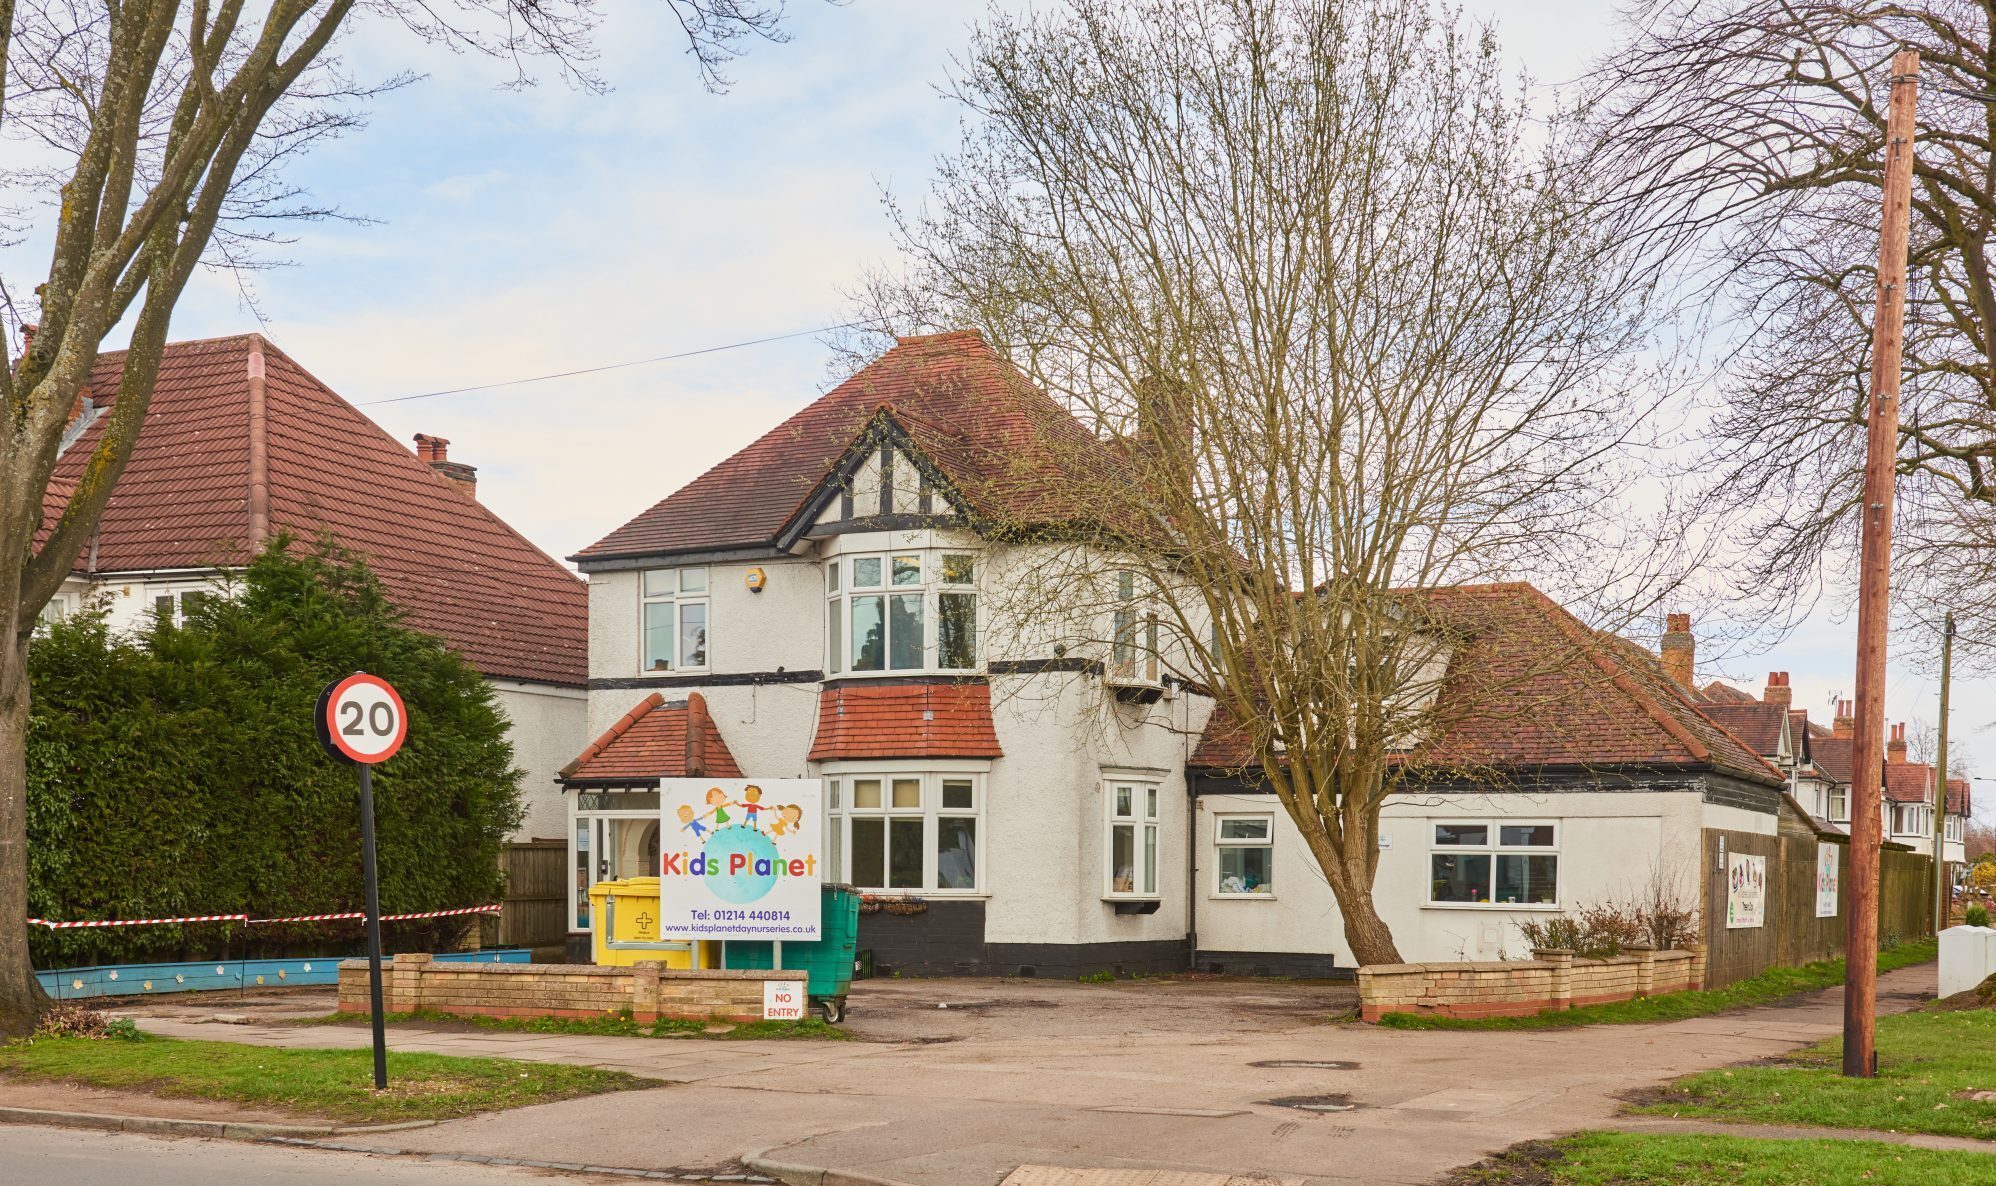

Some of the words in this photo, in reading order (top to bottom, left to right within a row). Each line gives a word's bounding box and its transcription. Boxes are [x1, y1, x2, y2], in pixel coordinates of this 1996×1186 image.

[340, 700, 395, 737] 20
[663, 851, 720, 876] Kids
[729, 852, 817, 877] Planet
[690, 910, 710, 921] Tel:
[713, 910, 746, 921] 01214
[748, 910, 791, 921] 440814
[665, 924, 817, 935] www.kidsplanetdaynurseries.co.uk
[775, 993, 792, 1003] NO
[767, 1007, 800, 1017] ENTRY
